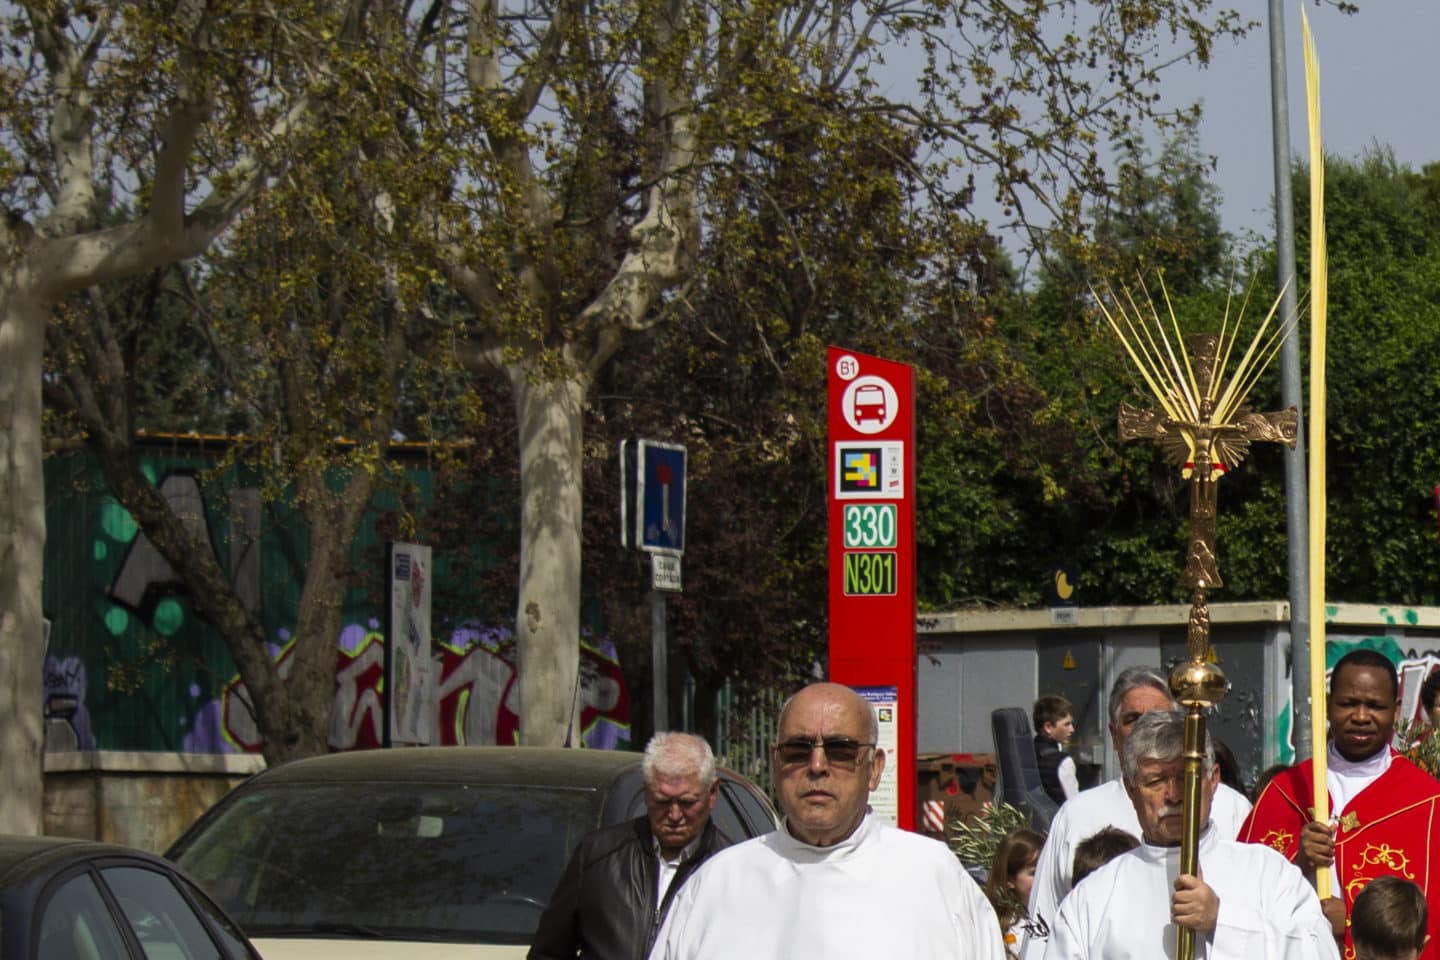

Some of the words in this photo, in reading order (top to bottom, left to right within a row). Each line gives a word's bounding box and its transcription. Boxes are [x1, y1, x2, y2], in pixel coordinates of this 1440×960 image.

[840, 361, 855, 375] B1
[847, 506, 894, 546] 330
[845, 554, 893, 594] N301
